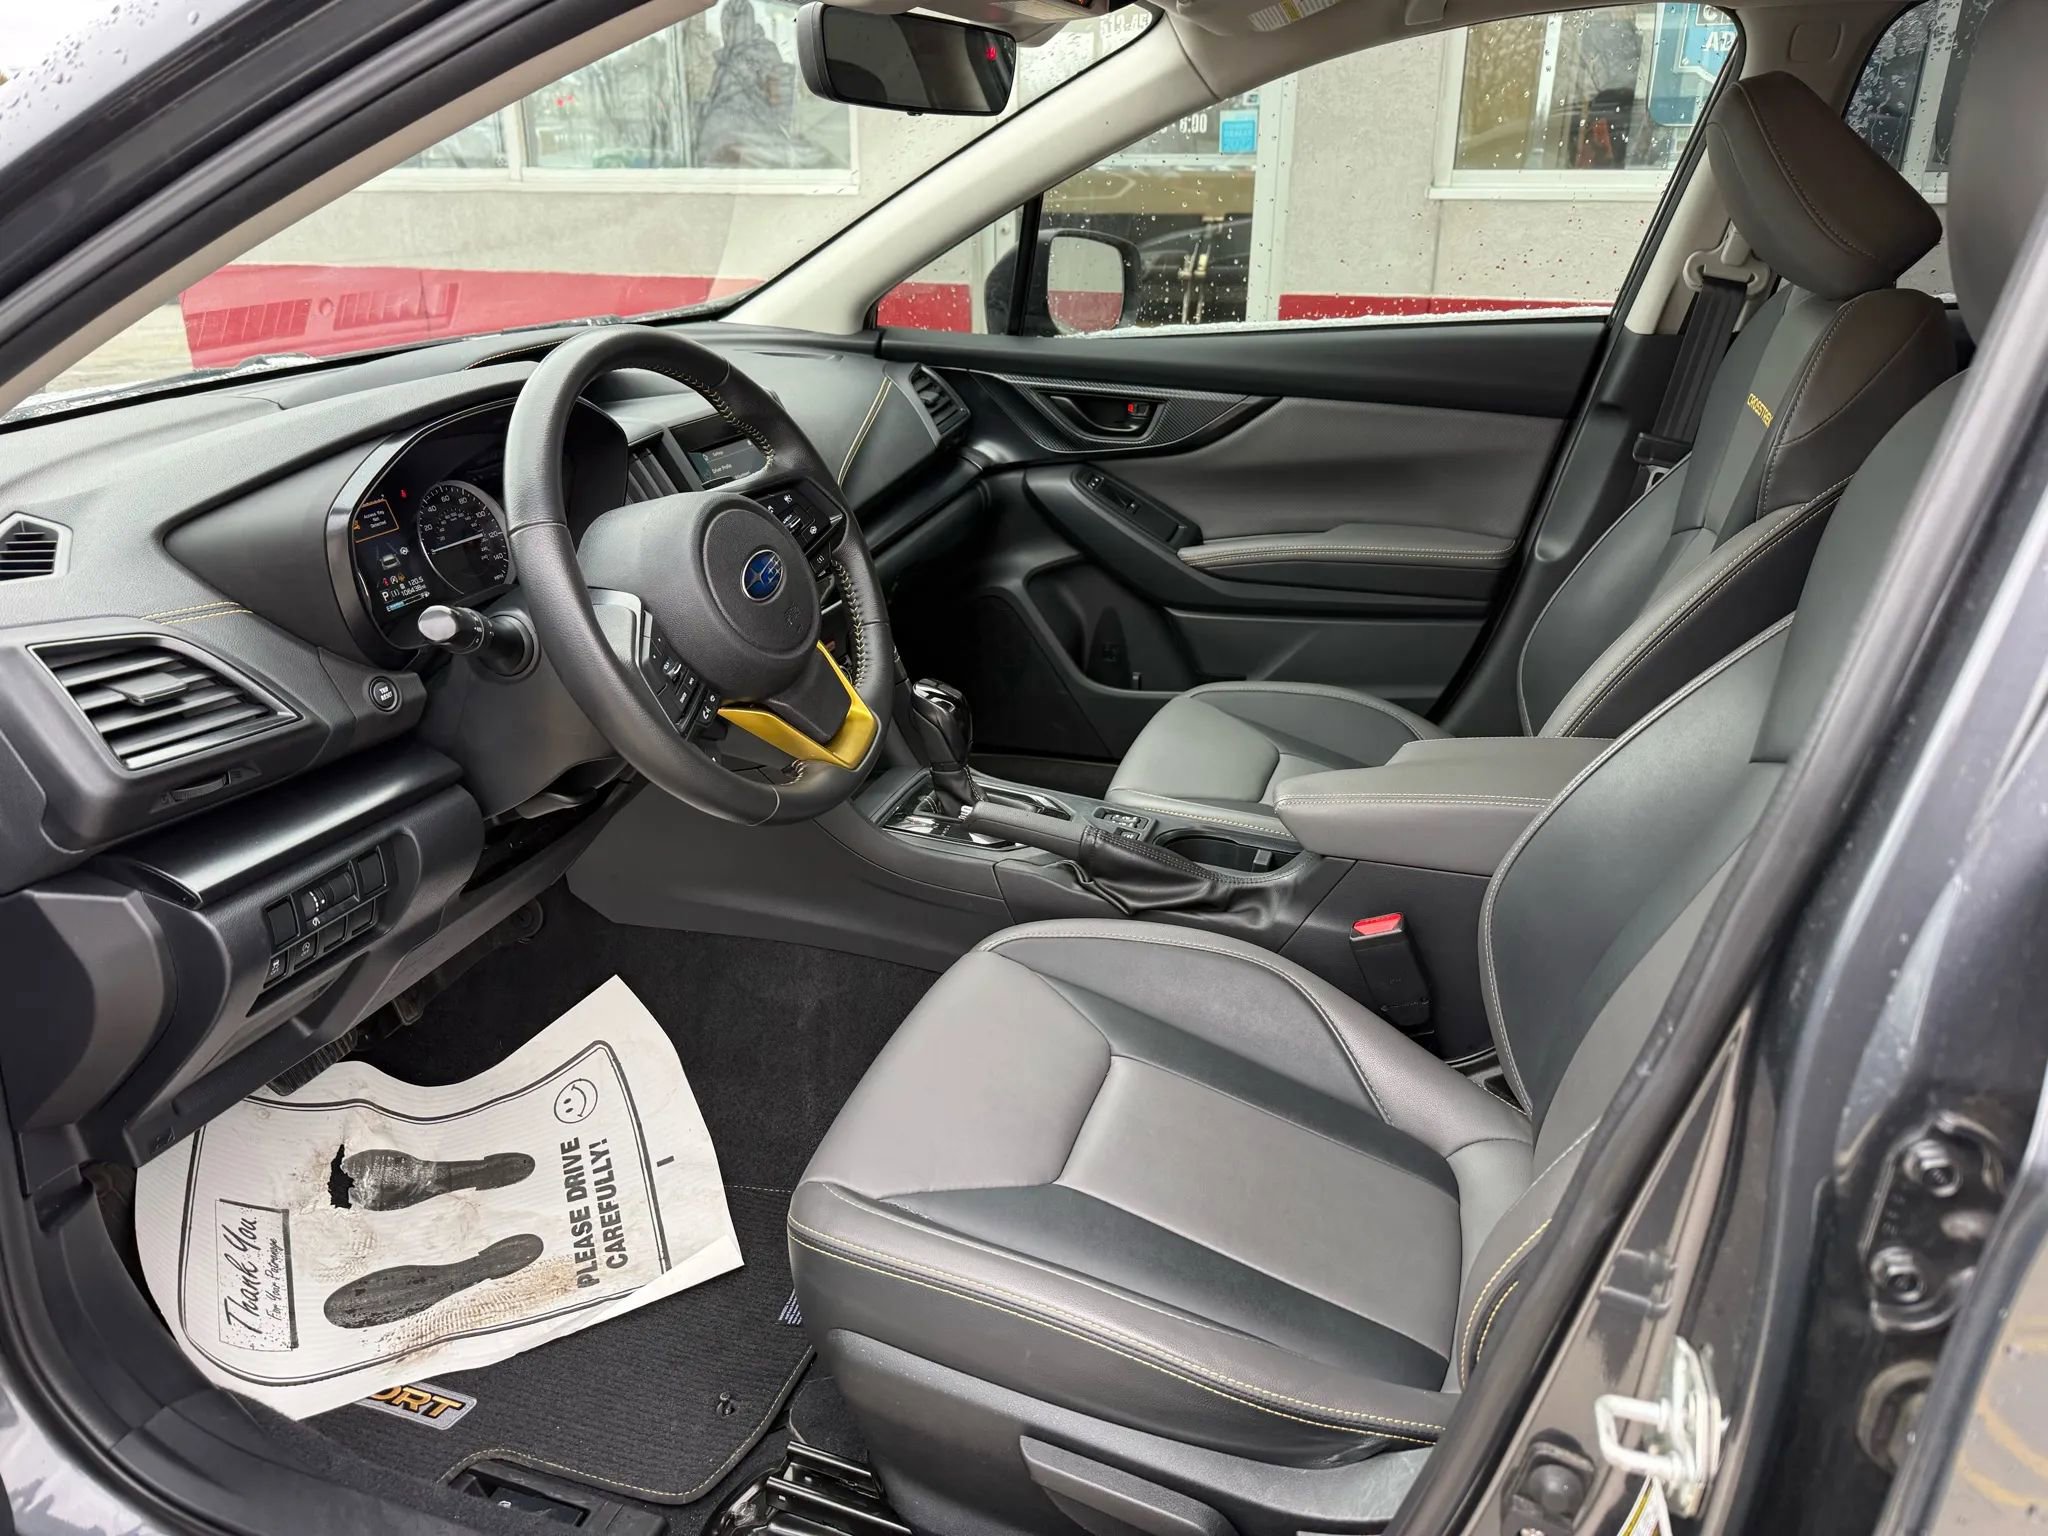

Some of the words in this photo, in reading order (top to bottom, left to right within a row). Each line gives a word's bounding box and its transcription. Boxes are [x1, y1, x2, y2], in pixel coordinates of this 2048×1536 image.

[441, 495, 450, 503] 60
[475, 510, 486, 518] 100
[423, 523, 433, 531] 20
[488, 530, 499, 538] 120
[493, 552, 504, 560] 140
[382, 591, 389, 602] P
[379, 686, 389, 694] TRIP
[380, 691, 393, 701] RESET
[560, 1137, 588, 1202] DRIVE
[589, 1138, 628, 1269] CAREFULLY!
[569, 1206, 600, 1288] PLEASE
[265, 1238, 284, 1280] Patronage
[224, 1253, 262, 1334] Thank
[266, 1282, 282, 1300] Your
[266, 1309, 281, 1321] For
